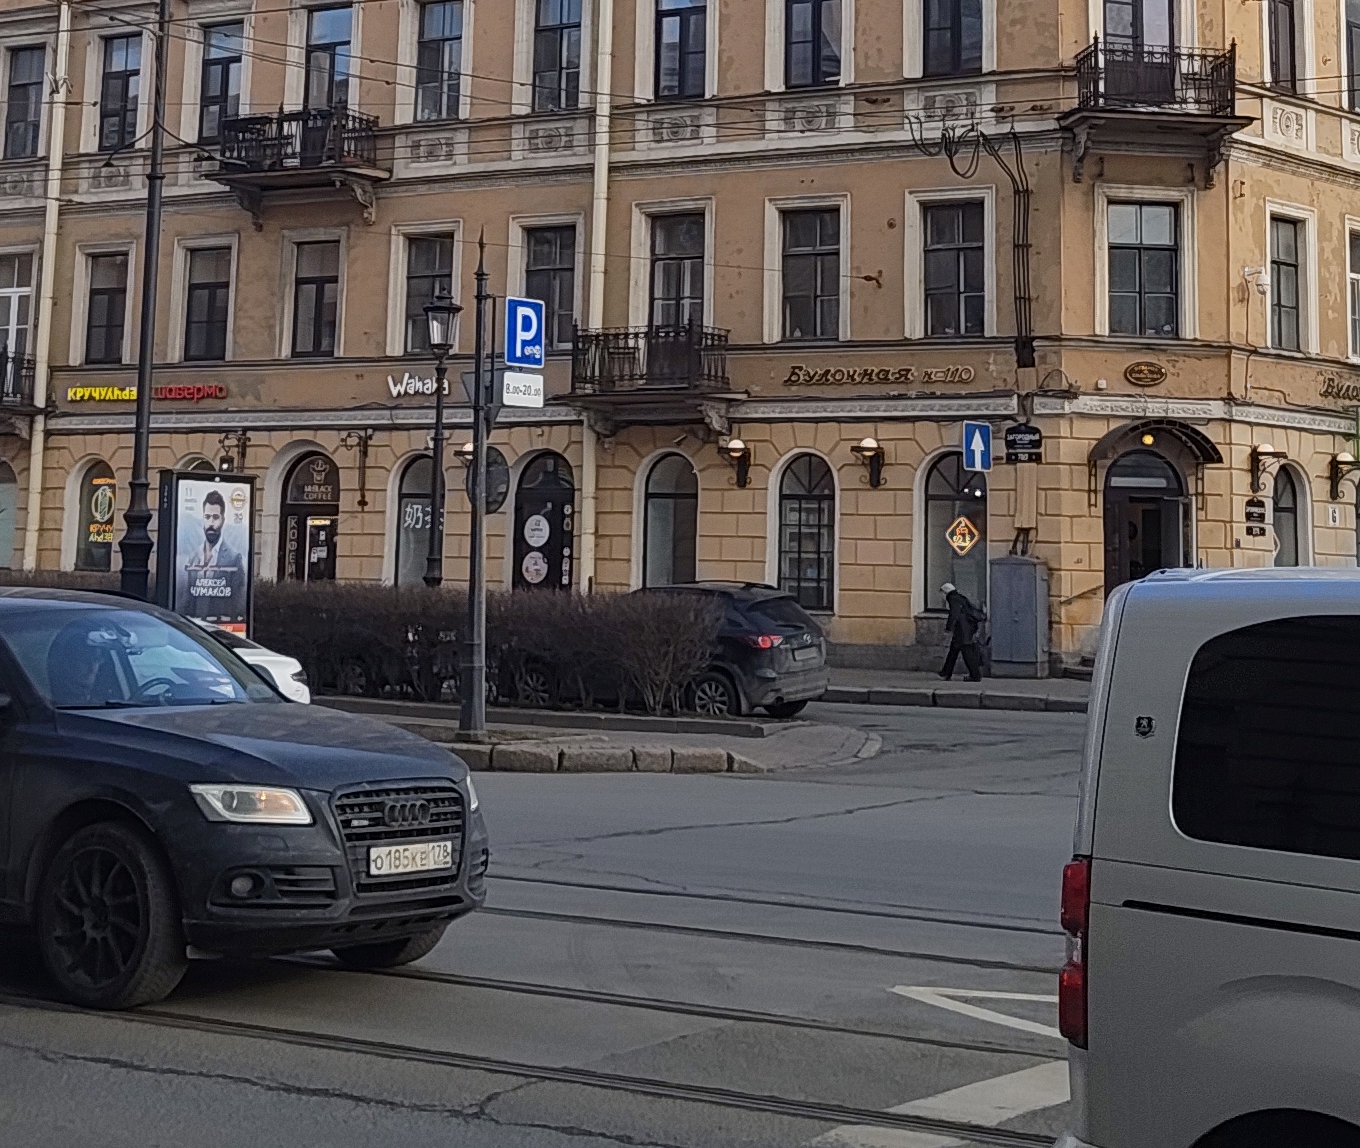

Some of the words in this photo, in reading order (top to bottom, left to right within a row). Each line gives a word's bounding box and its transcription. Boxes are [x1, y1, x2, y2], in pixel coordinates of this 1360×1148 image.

[516, 306, 538, 358] P
[784, 365, 913, 384] Булочная
[190, 586, 232, 597] ЧУМАКОВ
